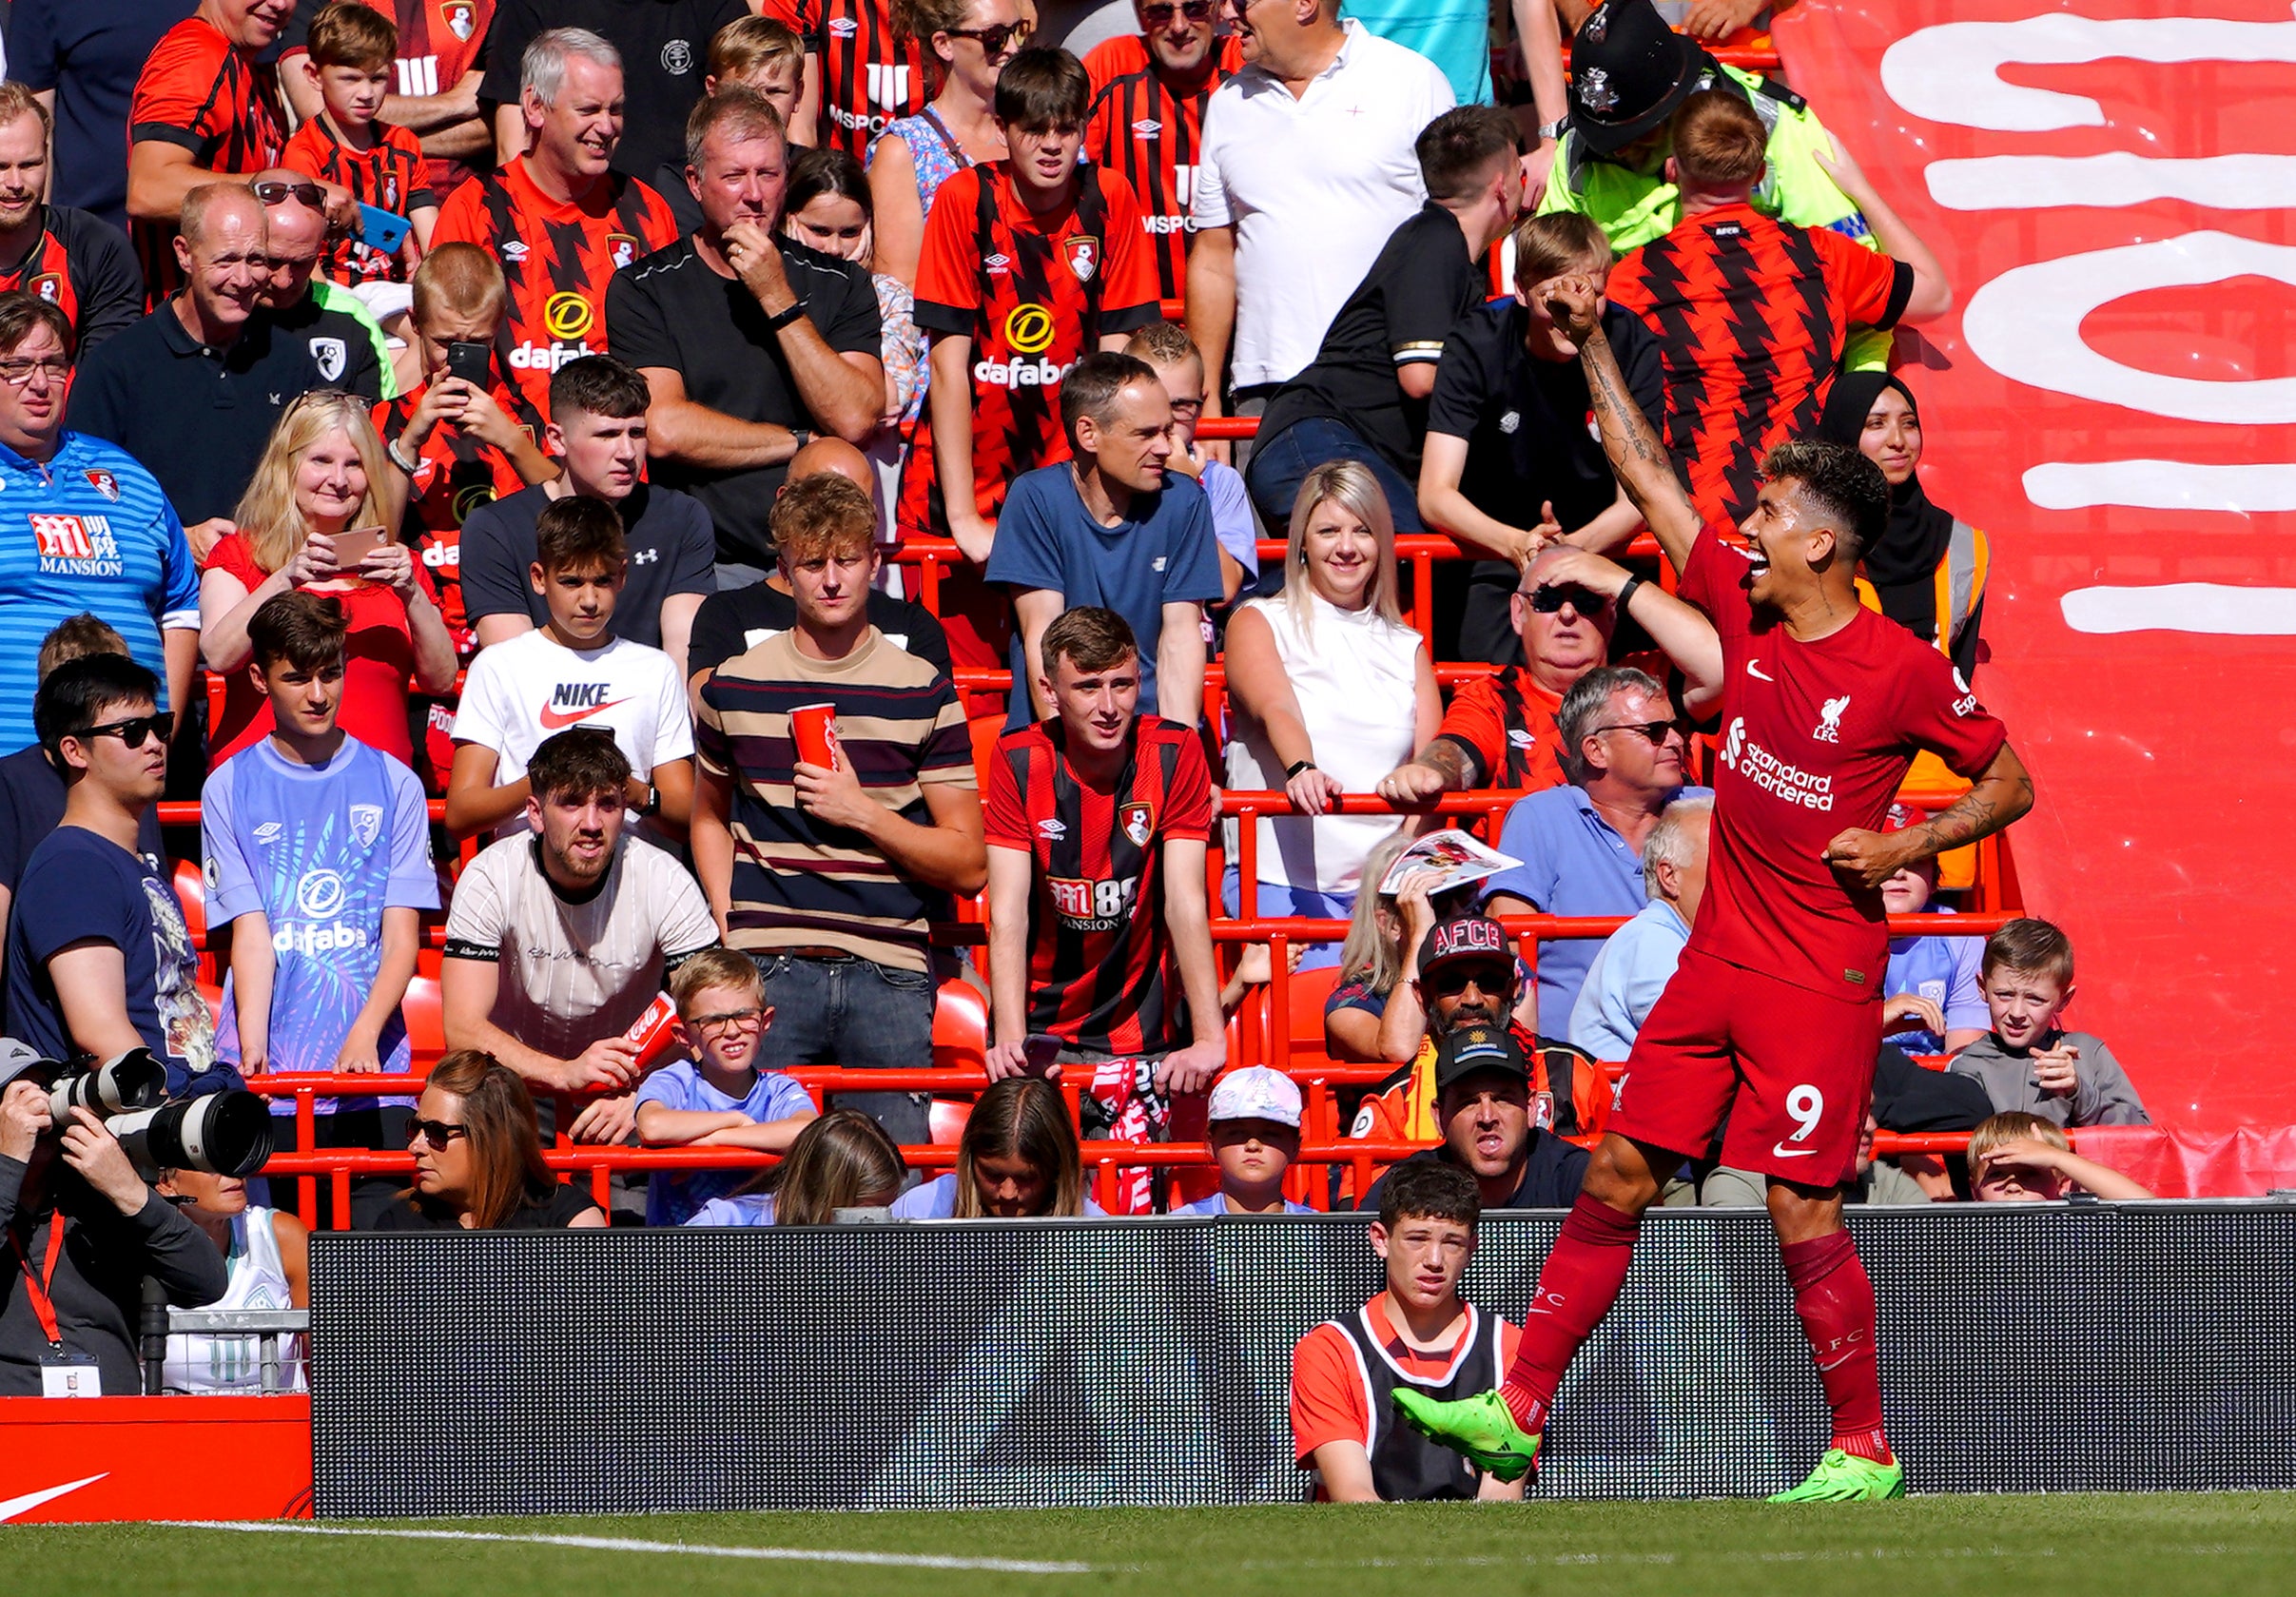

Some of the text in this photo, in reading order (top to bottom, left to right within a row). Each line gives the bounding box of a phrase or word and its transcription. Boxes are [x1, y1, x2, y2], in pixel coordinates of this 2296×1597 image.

[39, 556, 124, 576] MANSION
[552, 683, 611, 707] NIKE
[1741, 758, 1834, 811] chartered
[1747, 742, 1832, 792] standard
[1433, 919, 1502, 955] AFCB
[1785, 1083, 1824, 1142] 9
